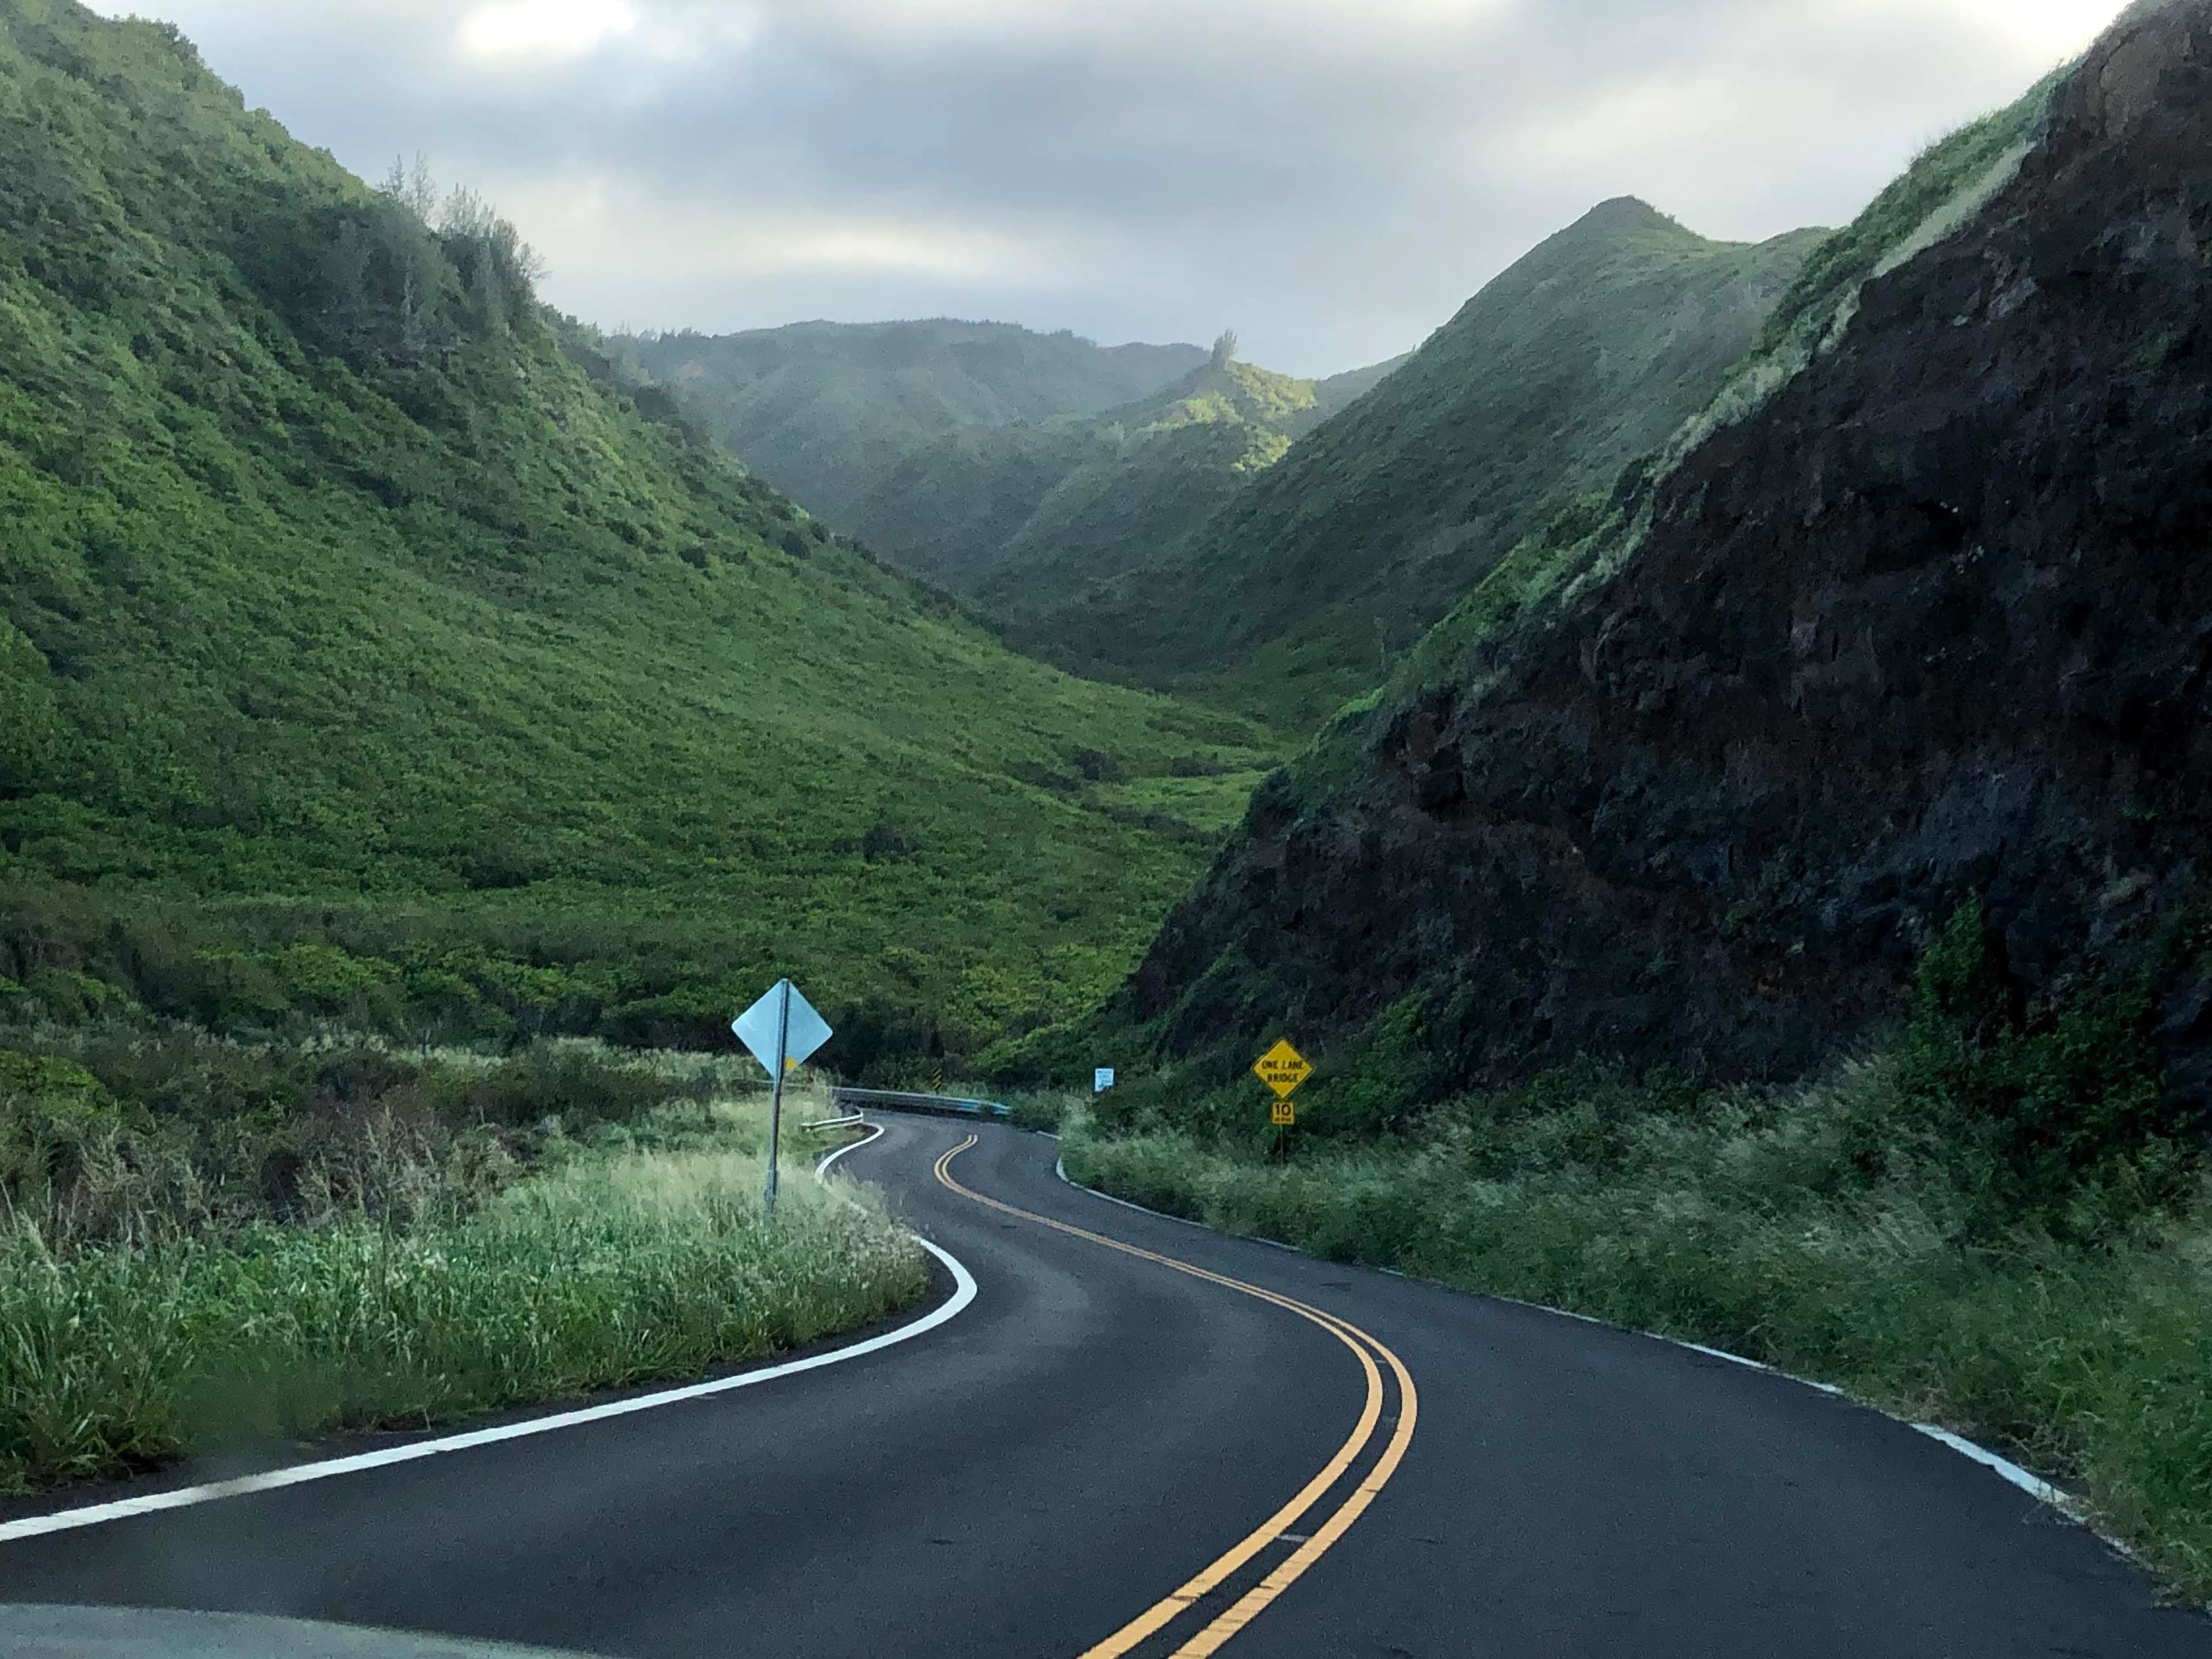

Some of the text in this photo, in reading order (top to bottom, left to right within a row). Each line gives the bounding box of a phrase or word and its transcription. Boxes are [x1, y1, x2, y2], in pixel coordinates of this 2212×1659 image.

[1262, 1060, 1304, 1069] ONE LANE
[1267, 1074, 1298, 1082] BRIDGE
[1275, 1104, 1291, 1115] 10
